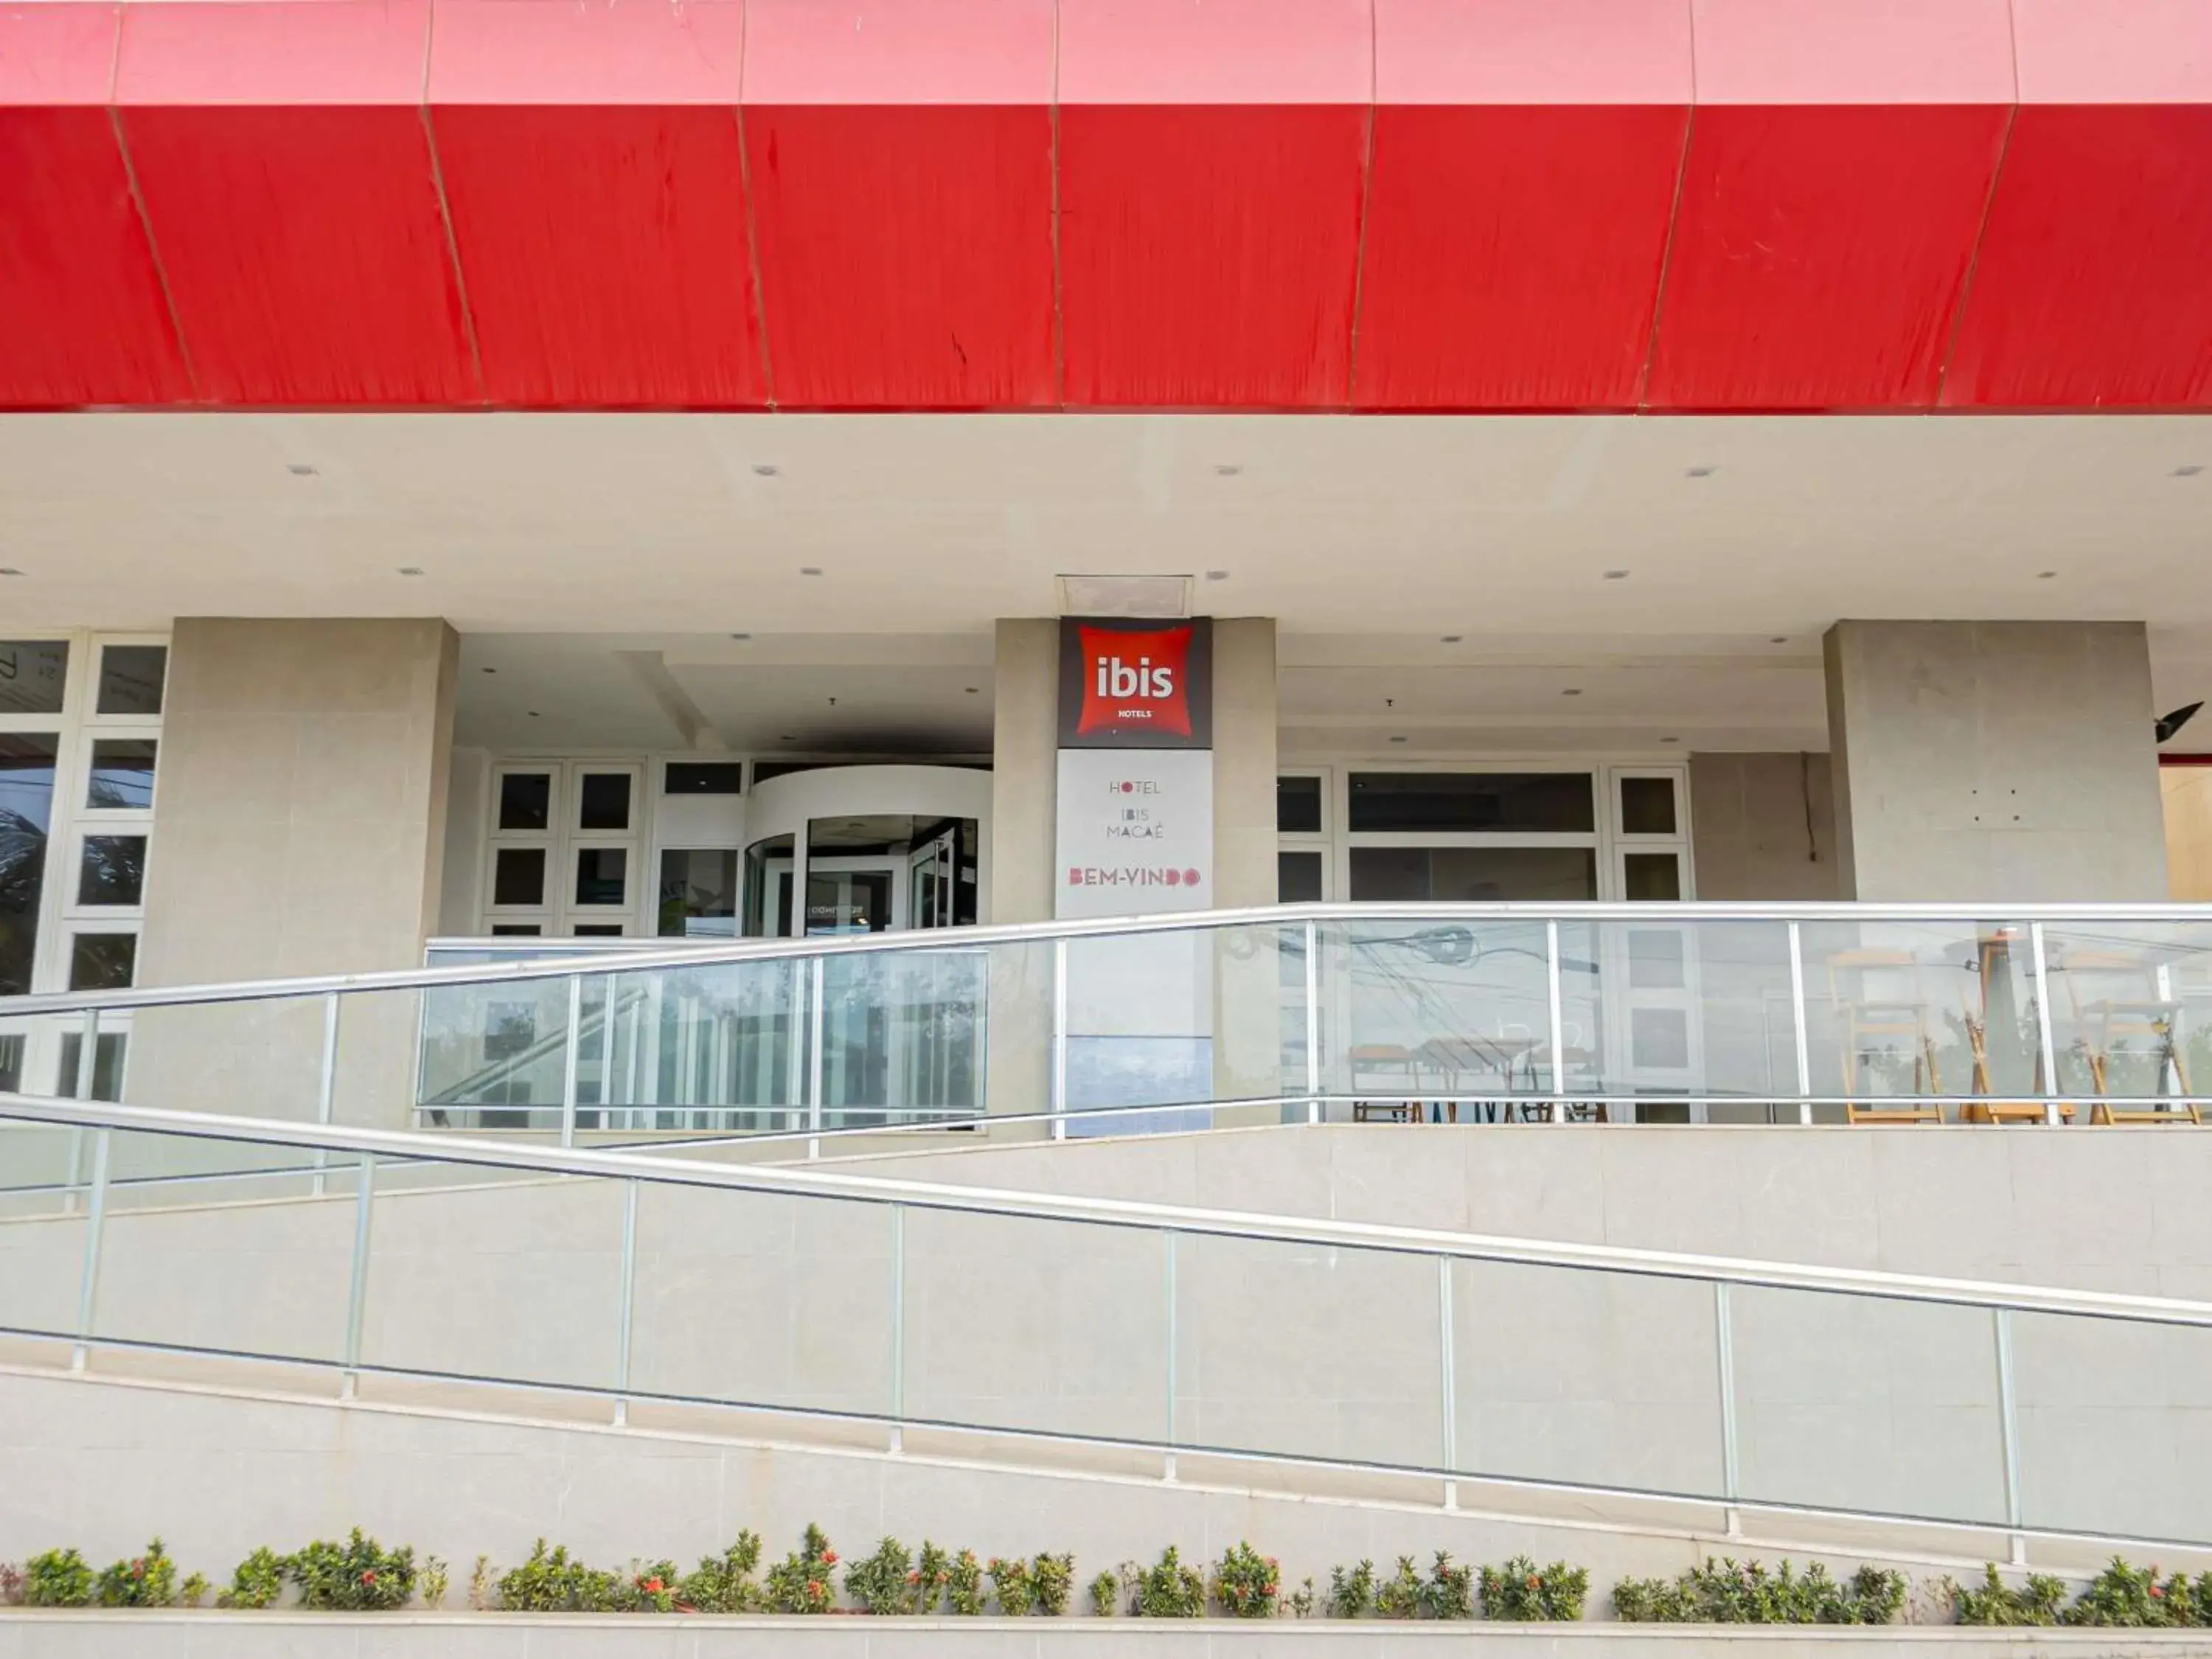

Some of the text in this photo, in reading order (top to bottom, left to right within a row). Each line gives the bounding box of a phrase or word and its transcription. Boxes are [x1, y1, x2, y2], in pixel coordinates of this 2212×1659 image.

[1098, 657, 1173, 698] ibis
[1118, 709, 1152, 717] HOTELS
[1110, 781, 1161, 794] HOTEL
[1121, 808, 1150, 821] IBIS
[1069, 867, 1201, 886] BEM-VINDO
